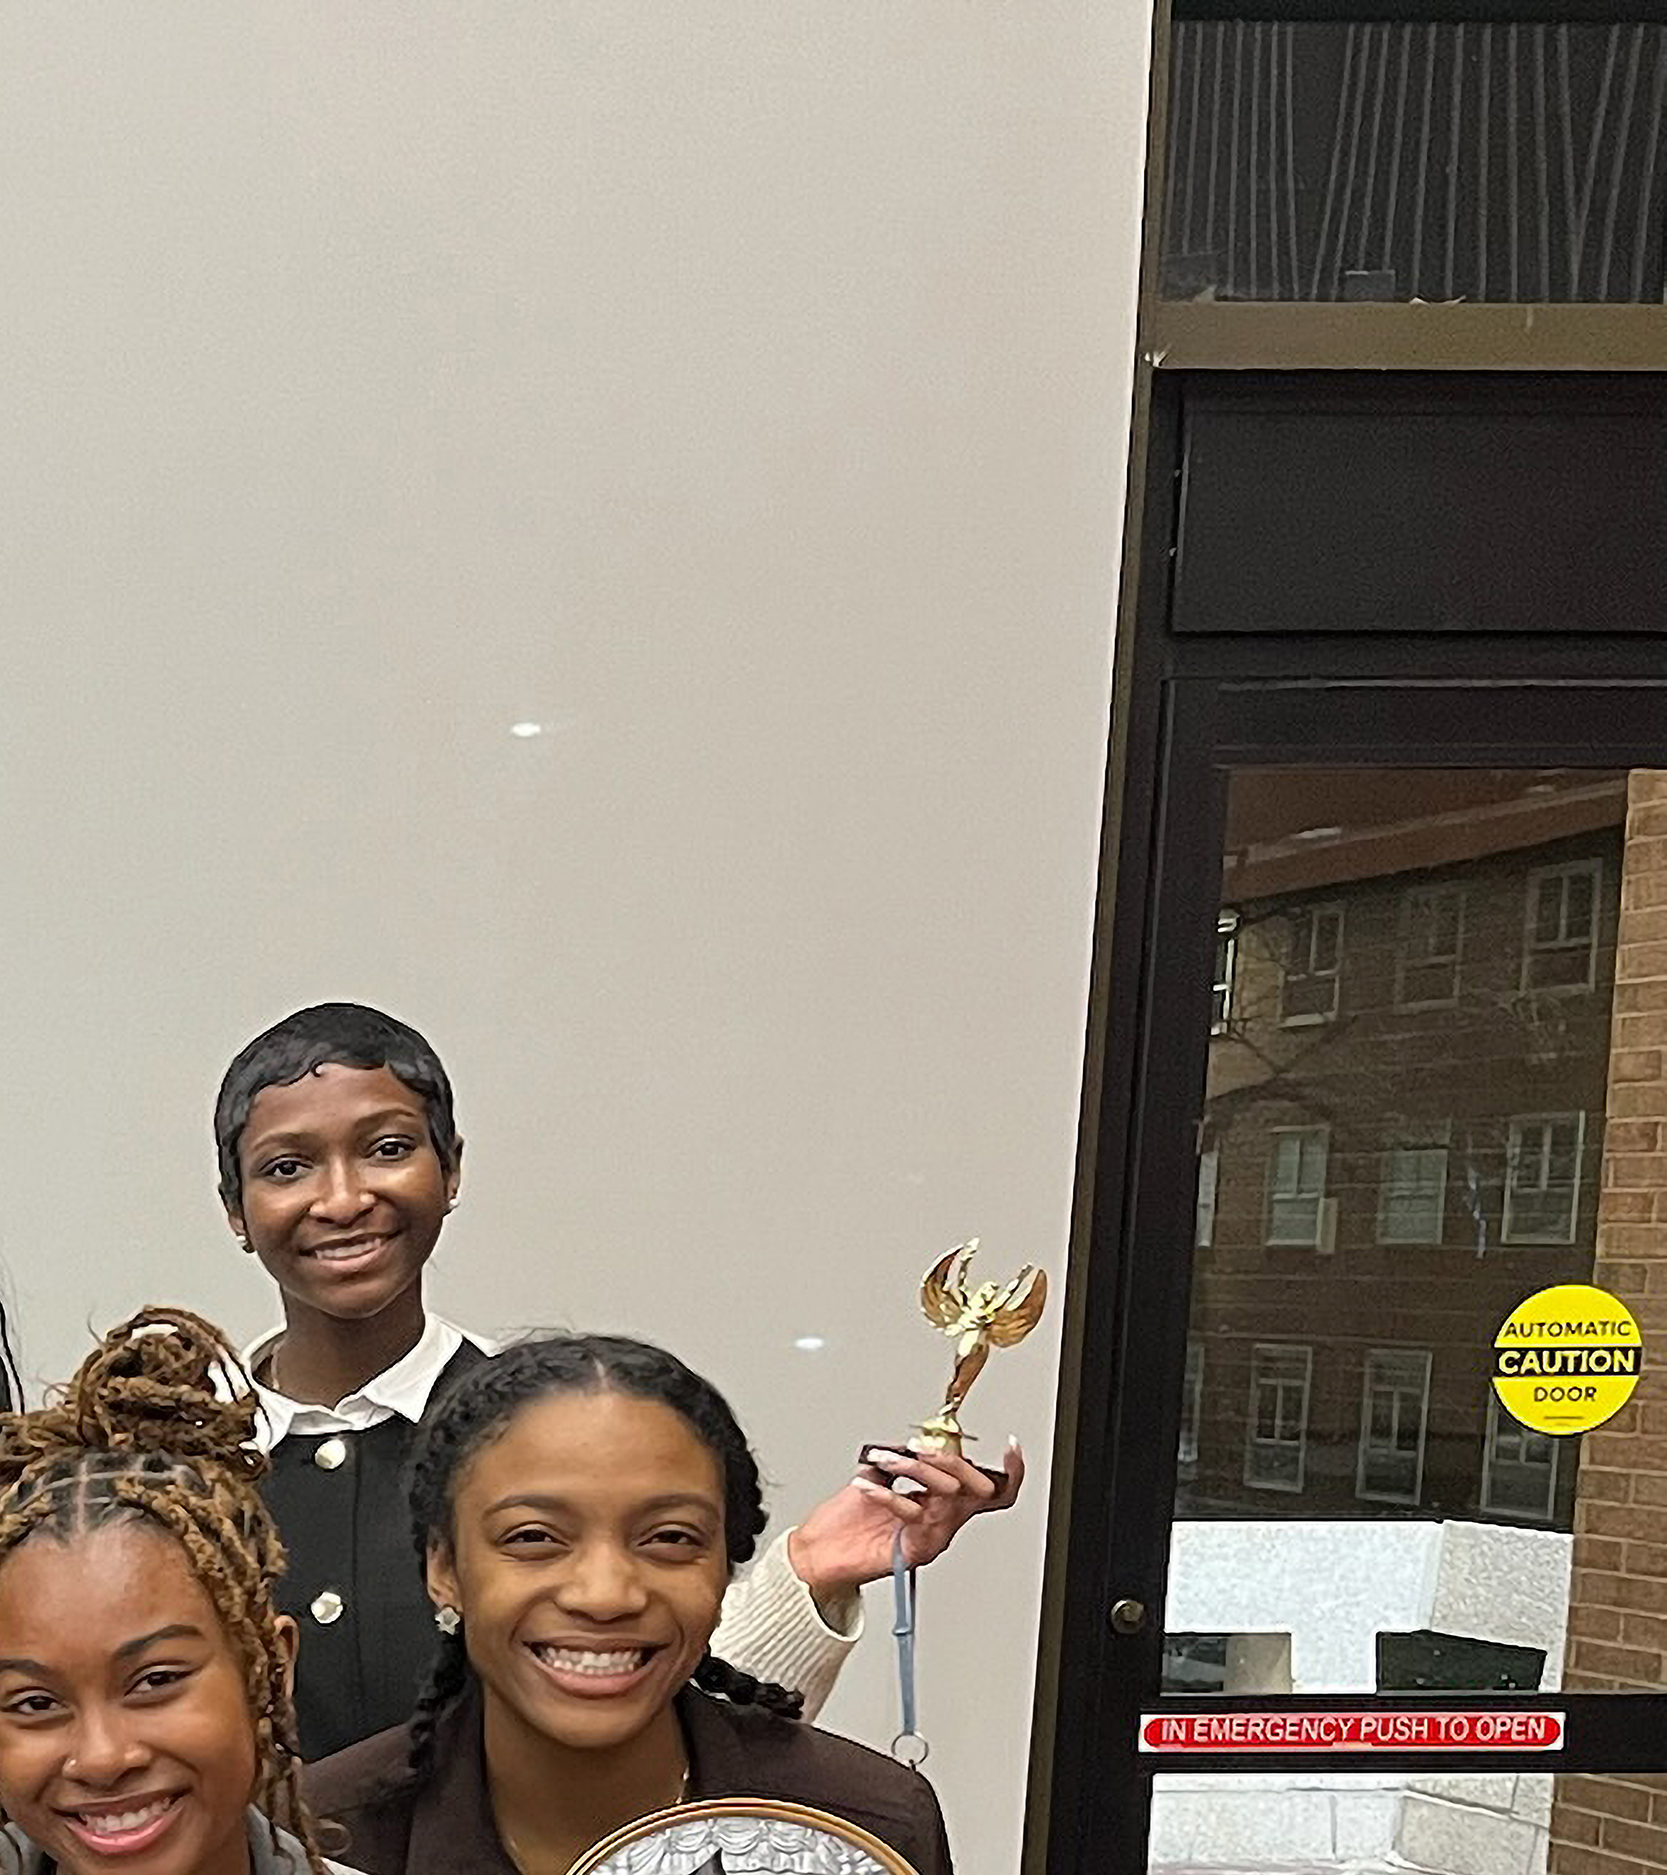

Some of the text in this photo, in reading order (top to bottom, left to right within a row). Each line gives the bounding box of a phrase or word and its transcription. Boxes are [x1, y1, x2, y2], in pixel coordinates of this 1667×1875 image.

[1504, 1320, 1632, 1338] AUTOMATIC
[1498, 1349, 1635, 1375] CAUTION
[1533, 1386, 1598, 1402] DOOR
[1161, 1716, 1547, 1742] IN EMERGENCY PUSH TO OPEN
